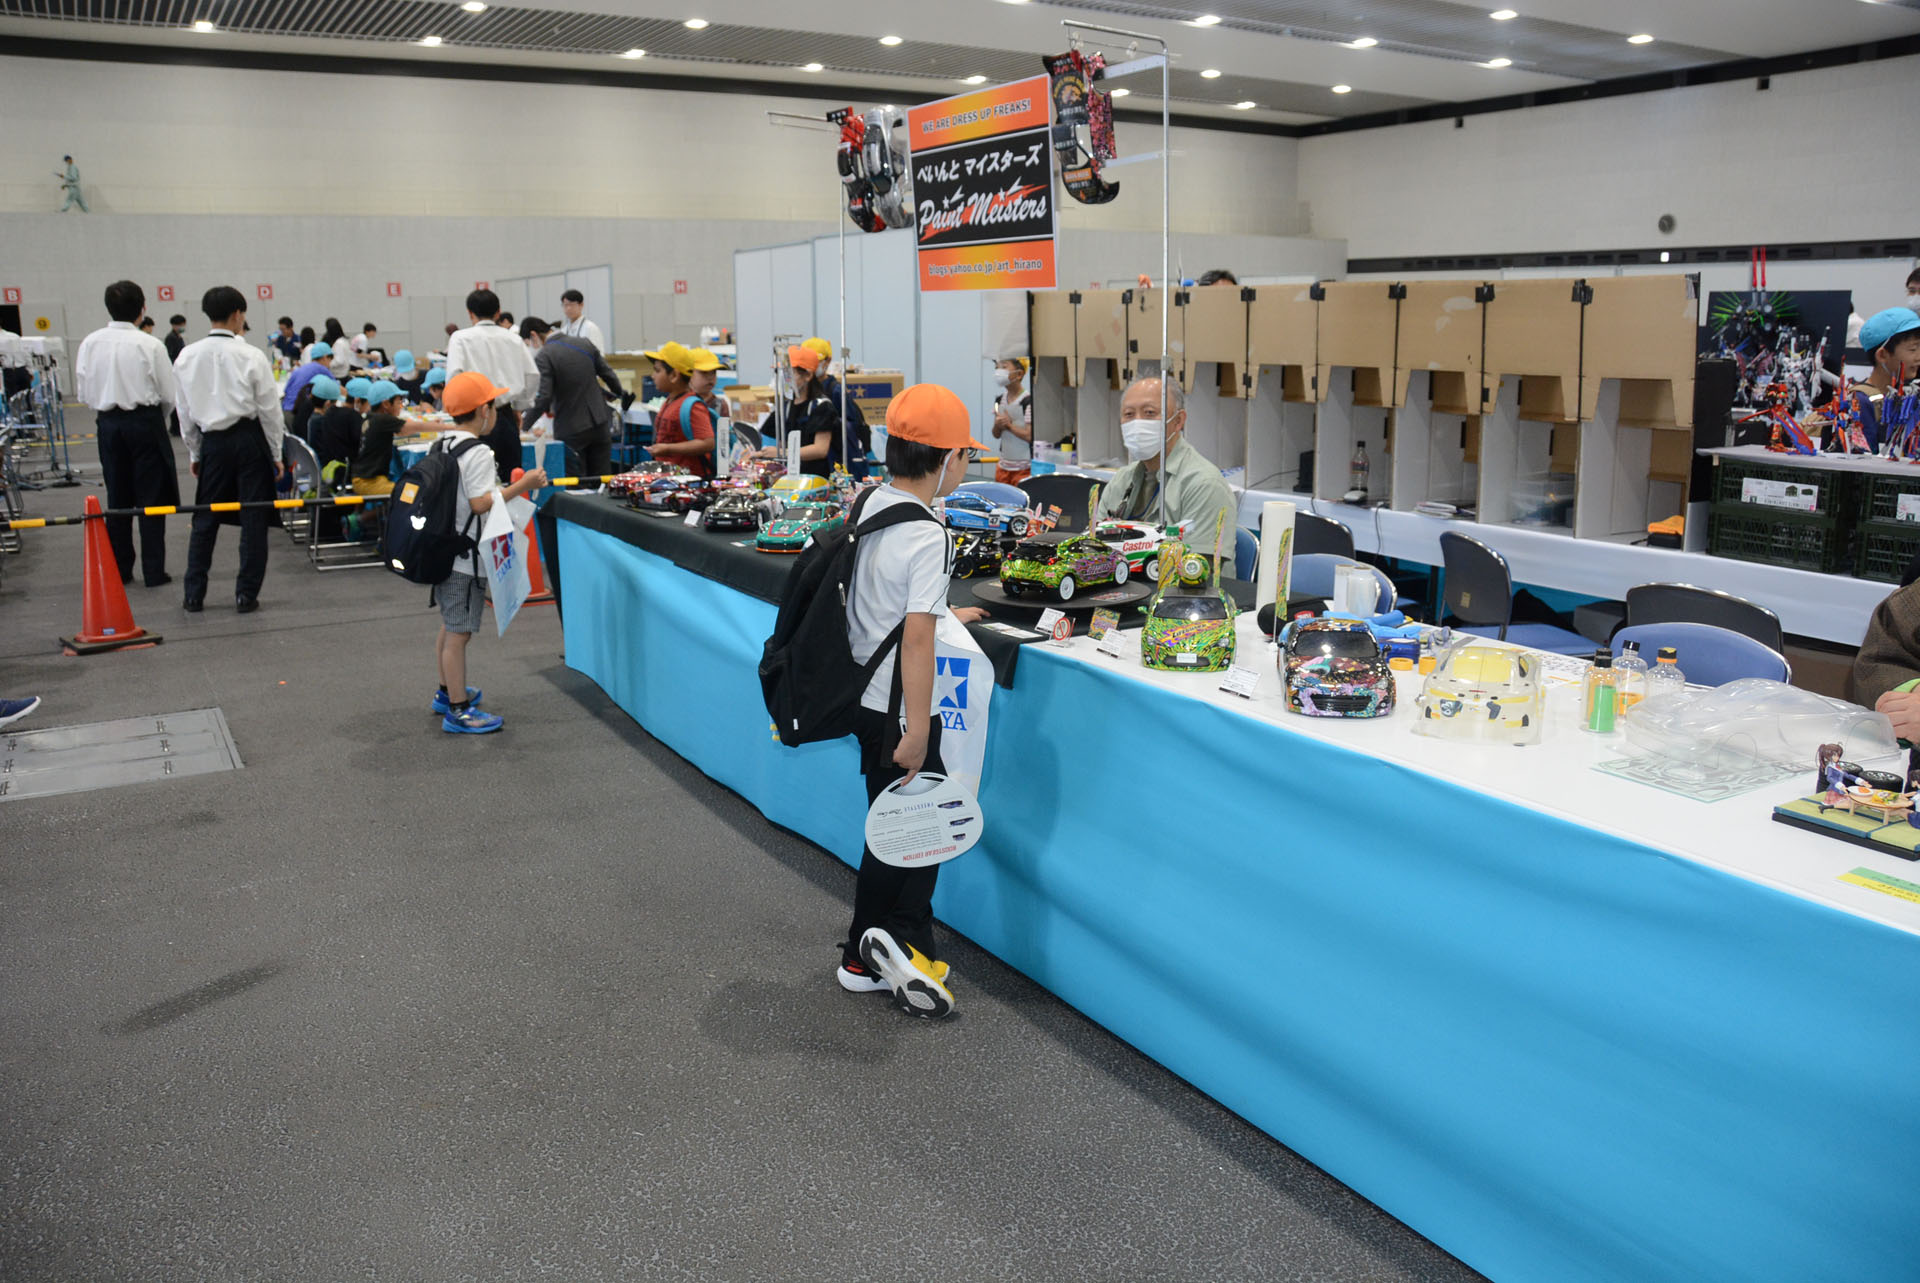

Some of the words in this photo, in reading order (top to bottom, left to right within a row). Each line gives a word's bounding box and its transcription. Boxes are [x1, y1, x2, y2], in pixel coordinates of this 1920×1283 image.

[922, 120, 934, 133] WE
[935, 116, 951, 129] ARE
[952, 110, 978, 126] DRESS
[980, 107, 992, 120] UP
[993, 98, 1032, 117] FREAKS!
[964, 142, 1043, 177] マイスターズ
[919, 197, 965, 235] Paint
[967, 192, 1048, 226] Meisters
[928, 257, 1043, 278] blogs.yahoo.co.jp/art_hirano
[8, 290, 18, 301] B
[161, 287, 171, 300] C
[260, 286, 270, 297] D
[390, 284, 399, 295] E
[1122, 541, 1154, 552] Castrol
[940, 710, 968, 731] YA
